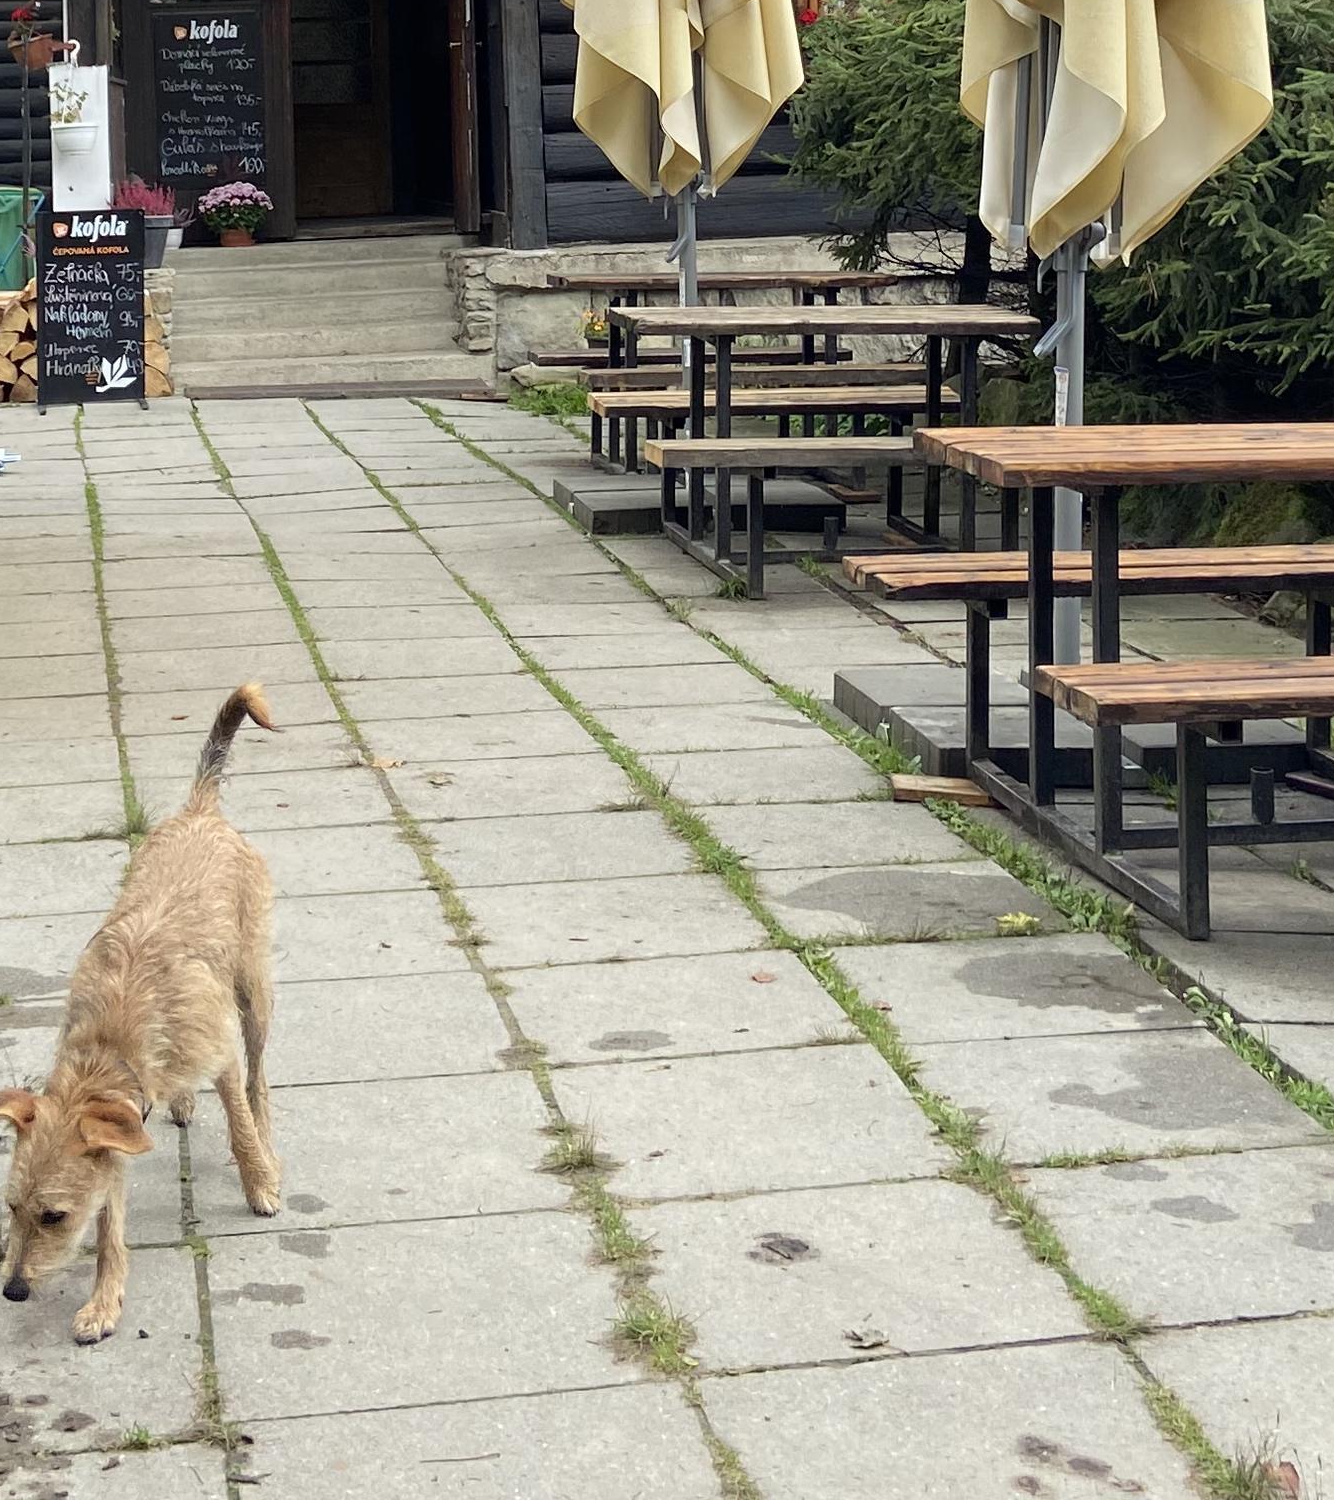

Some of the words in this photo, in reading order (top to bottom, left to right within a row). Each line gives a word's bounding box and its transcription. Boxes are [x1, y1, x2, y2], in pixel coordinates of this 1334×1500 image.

[189, 19, 238, 45] kofola
[70, 214, 127, 243] kofola
[52, 246, 96, 256] ČEPOVANÁ
[97, 246, 130, 255] KOFOLA
